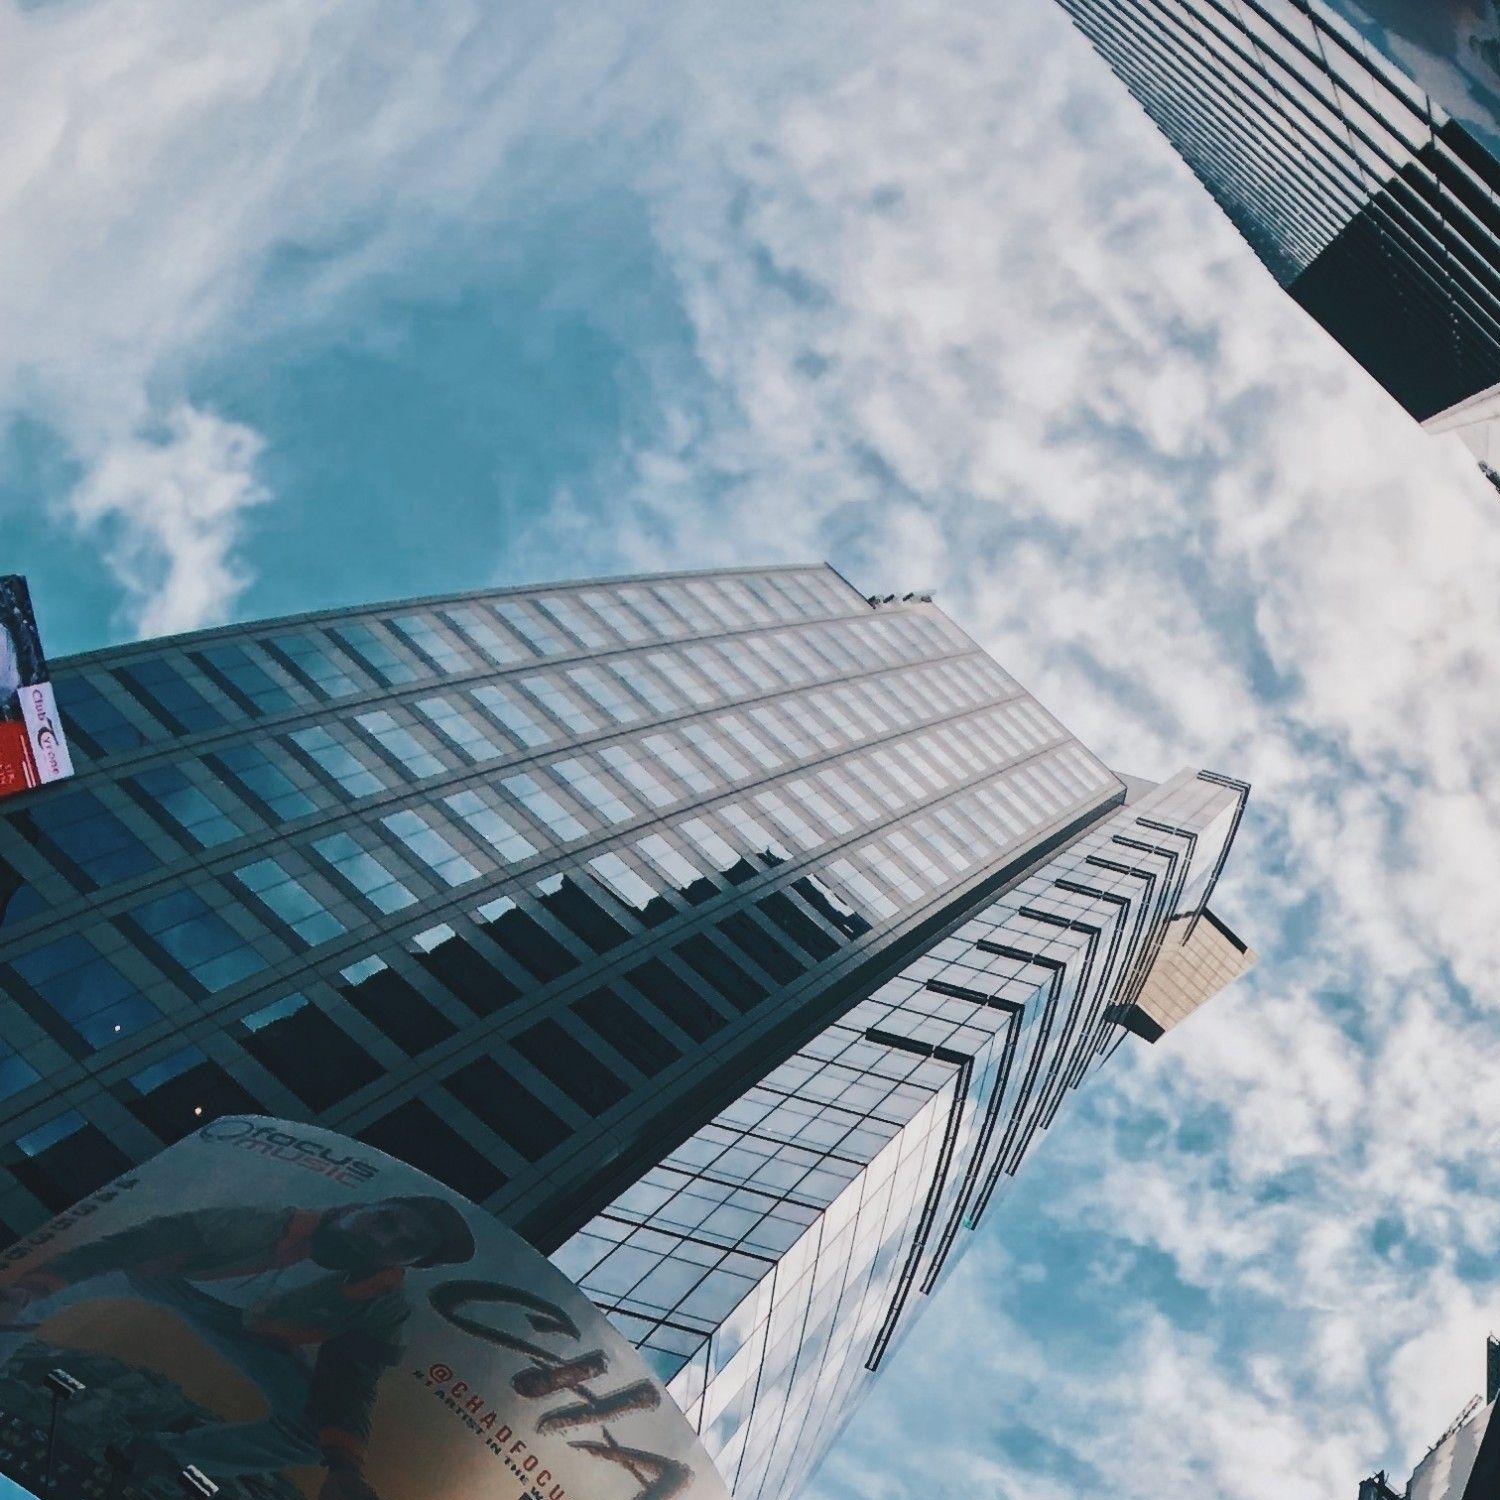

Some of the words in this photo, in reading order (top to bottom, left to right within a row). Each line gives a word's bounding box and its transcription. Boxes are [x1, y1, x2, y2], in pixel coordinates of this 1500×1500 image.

[33, 689, 46, 722] Club
[433, 1388, 485, 1436] ARTIST
[485, 1438, 503, 1456] IN
[505, 1455, 530, 1487] THE
